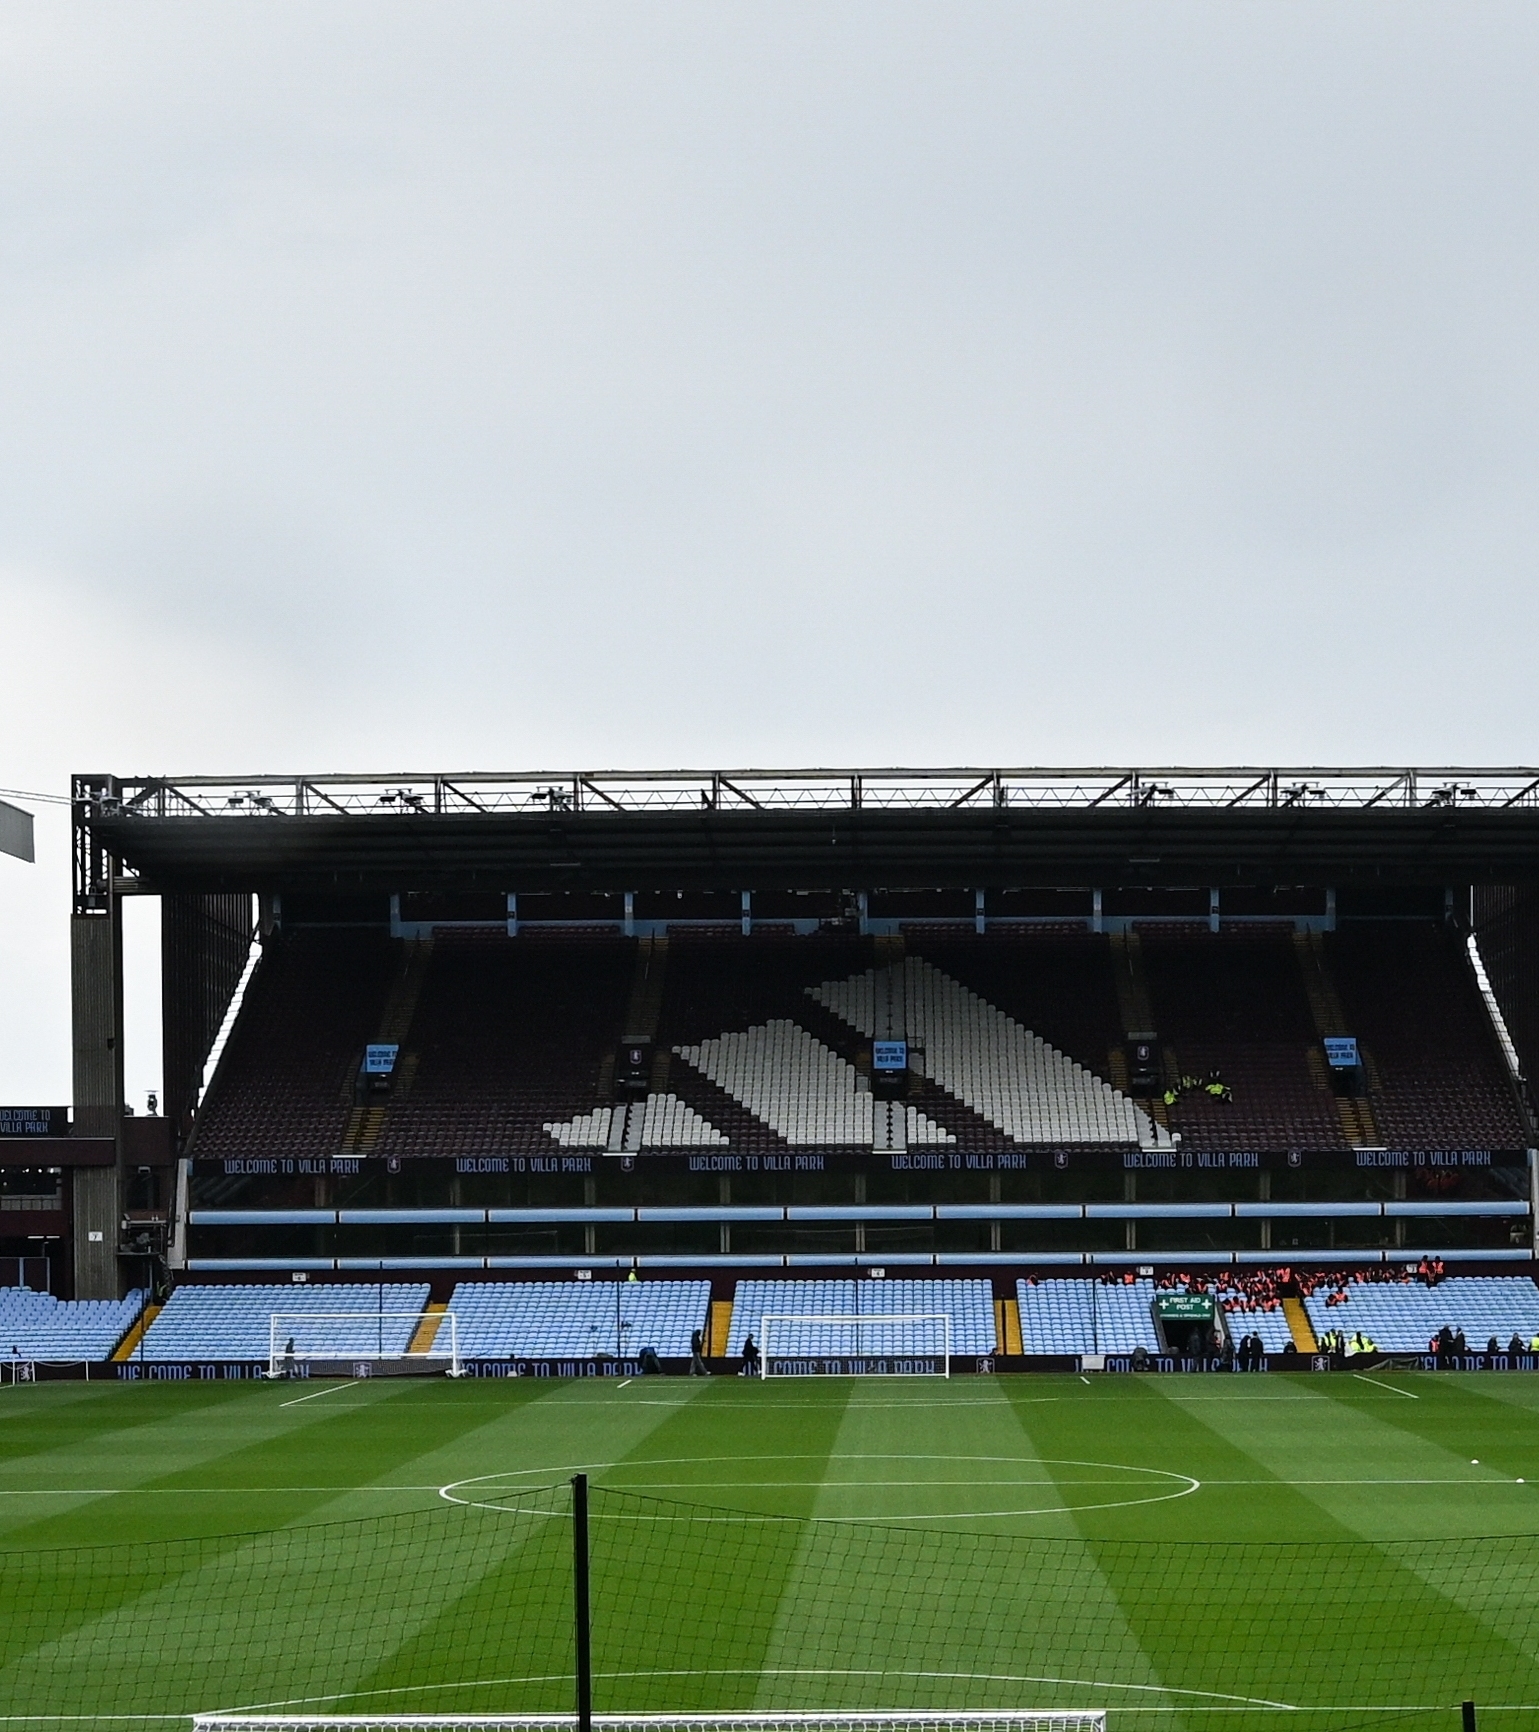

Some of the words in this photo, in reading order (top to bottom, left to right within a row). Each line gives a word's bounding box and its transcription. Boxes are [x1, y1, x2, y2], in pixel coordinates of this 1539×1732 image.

[40, 1109, 51, 1121] TO
[0, 1120, 22, 1133] VILLA
[25, 1120, 49, 1133] PARK
[224, 1157, 278, 1174] WELCOME
[280, 1157, 295, 1174] TO
[297, 1157, 327, 1174] VILLA
[330, 1157, 360, 1174] PARK
[456, 1157, 510, 1173] WELCOME
[512, 1157, 527, 1173] TO
[529, 1157, 558, 1173] VILLA
[561, 1157, 592, 1173] PARK
[689, 1156, 743, 1171] WELCOME
[745, 1156, 760, 1171] TO
[763, 1156, 791, 1171] VILLA
[794, 1156, 826, 1171] PARK
[891, 1155, 945, 1170] WELCOME
[947, 1155, 962, 1170] TO
[965, 1155, 994, 1170] VILLA
[997, 1155, 1028, 1170] PARK
[1123, 1153, 1177, 1168] WELCOME
[1179, 1153, 1194, 1168] TO
[1197, 1153, 1226, 1168] VILLA
[1228, 1153, 1260, 1168] PARK
[1355, 1152, 1410, 1167] WELCOME
[1412, 1152, 1427, 1167] TO
[1430, 1152, 1459, 1167] VILLA
[1462, 1152, 1492, 1167] PARK
[463, 1362, 526, 1377] ELCOME
